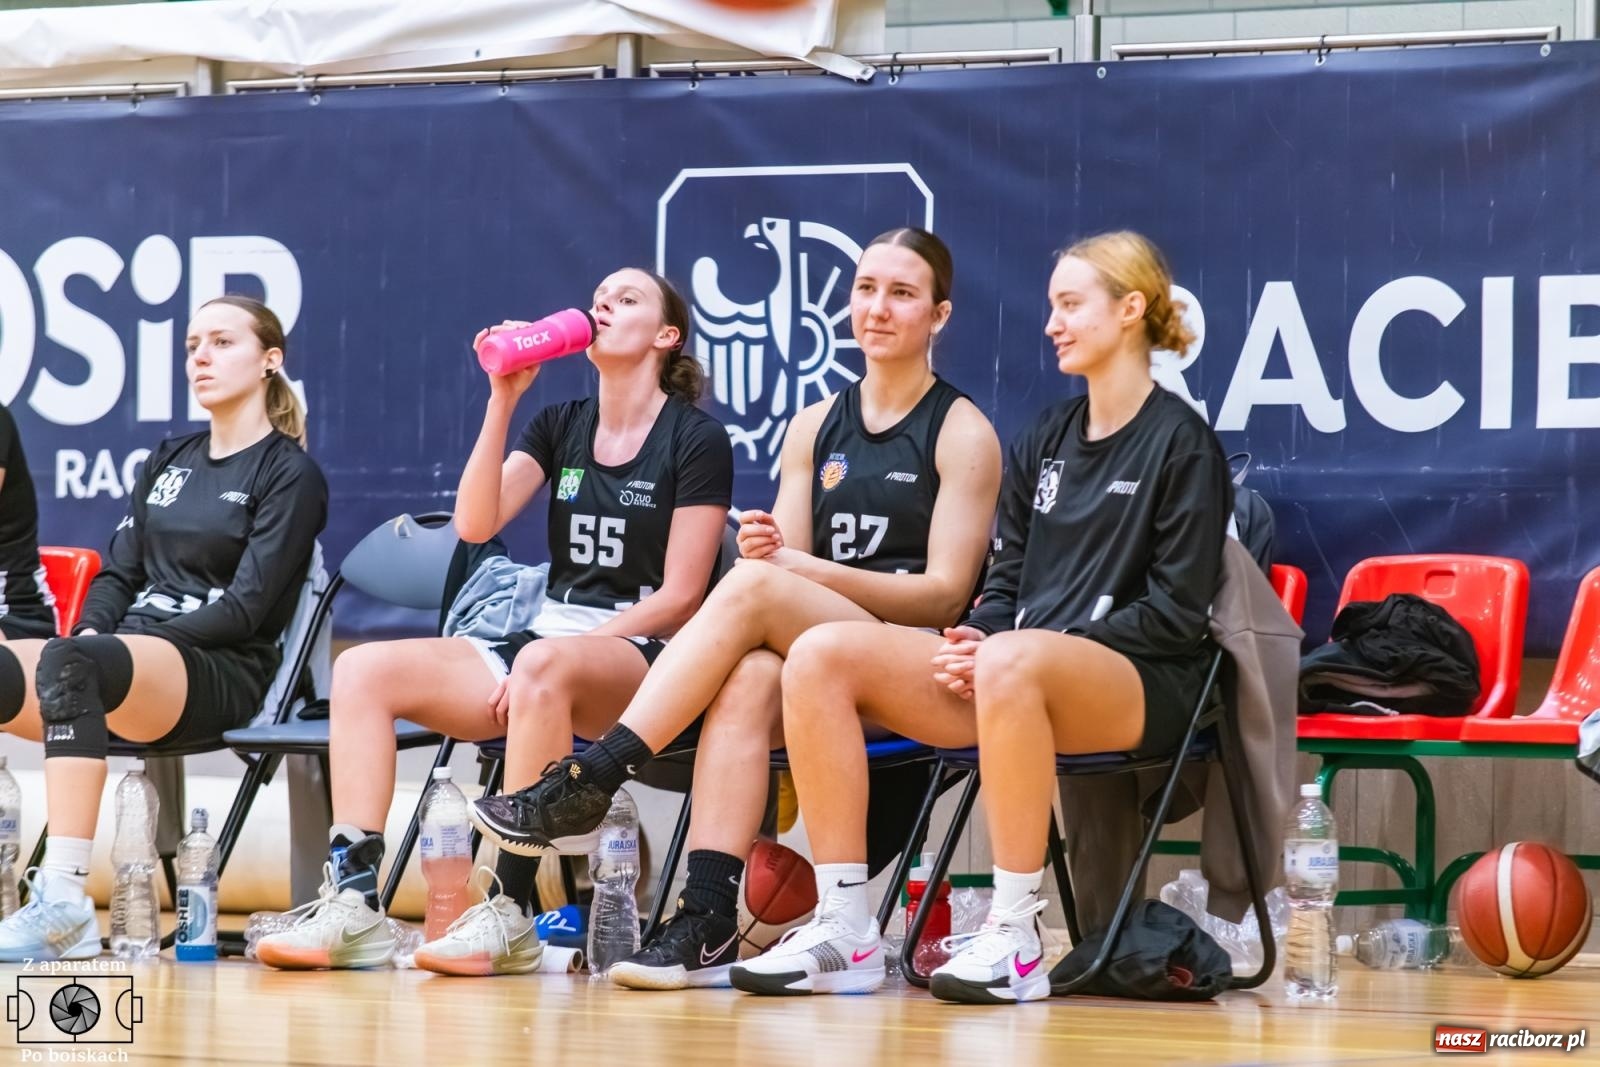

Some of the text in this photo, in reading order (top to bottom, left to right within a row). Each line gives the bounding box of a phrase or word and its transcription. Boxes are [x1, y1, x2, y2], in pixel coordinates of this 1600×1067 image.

[513, 330, 552, 351] Tacx
[630, 480, 656, 490] PROTON
[889, 471, 918, 483] PROTON
[569, 513, 626, 568] 55
[831, 512, 889, 561] 27
[179, 888, 189, 943] OSHEE
